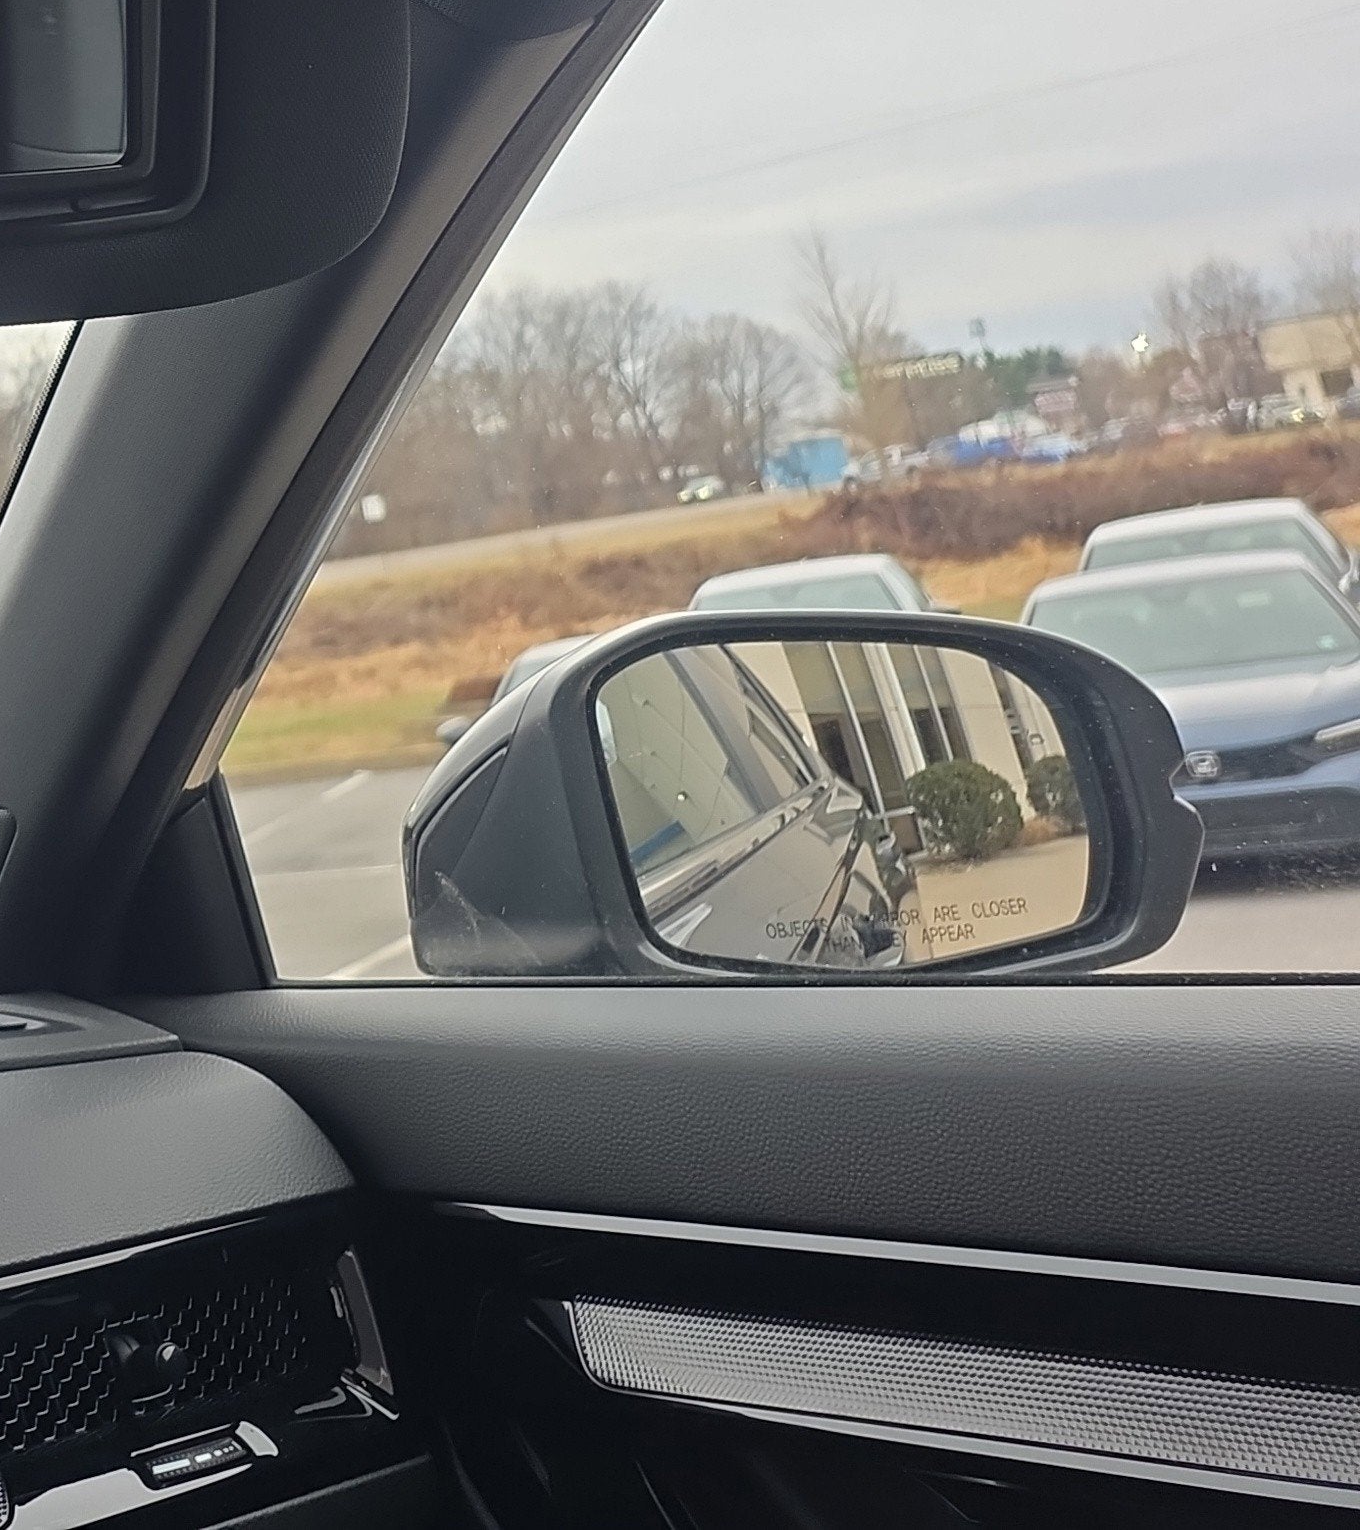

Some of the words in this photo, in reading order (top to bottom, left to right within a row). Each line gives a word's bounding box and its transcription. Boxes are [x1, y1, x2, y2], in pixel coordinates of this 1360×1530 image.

[863, 908, 921, 930] RROR
[933, 906, 961, 923] ARE
[971, 897, 1030, 919] CLOSER
[921, 923, 976, 945] APPEAR
